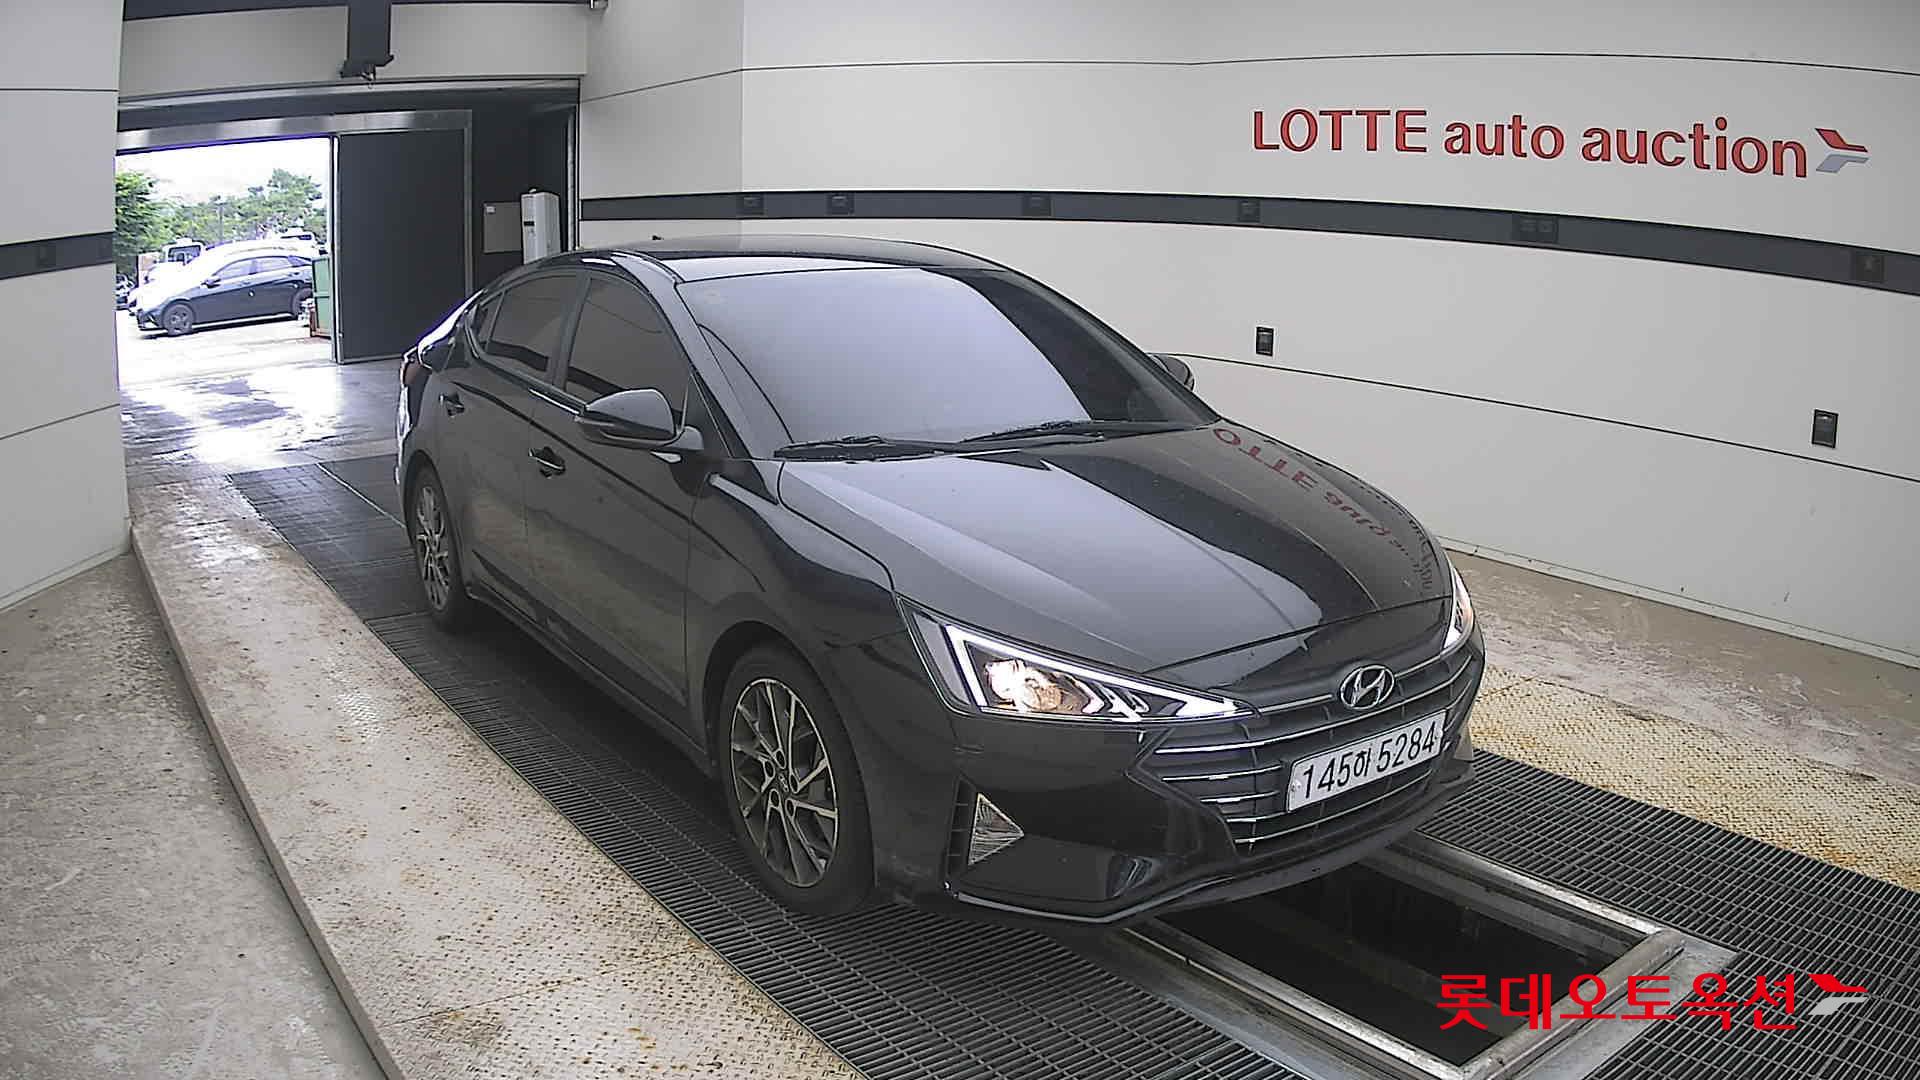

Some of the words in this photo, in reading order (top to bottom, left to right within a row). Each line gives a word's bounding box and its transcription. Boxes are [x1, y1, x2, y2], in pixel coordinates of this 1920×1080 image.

[1254, 110, 1427, 152] LOTTE
[1444, 115, 1566, 158] auto
[1582, 117, 1807, 178] auction
[1303, 748, 1372, 798] 145하
[1377, 721, 1436, 772] 5284
